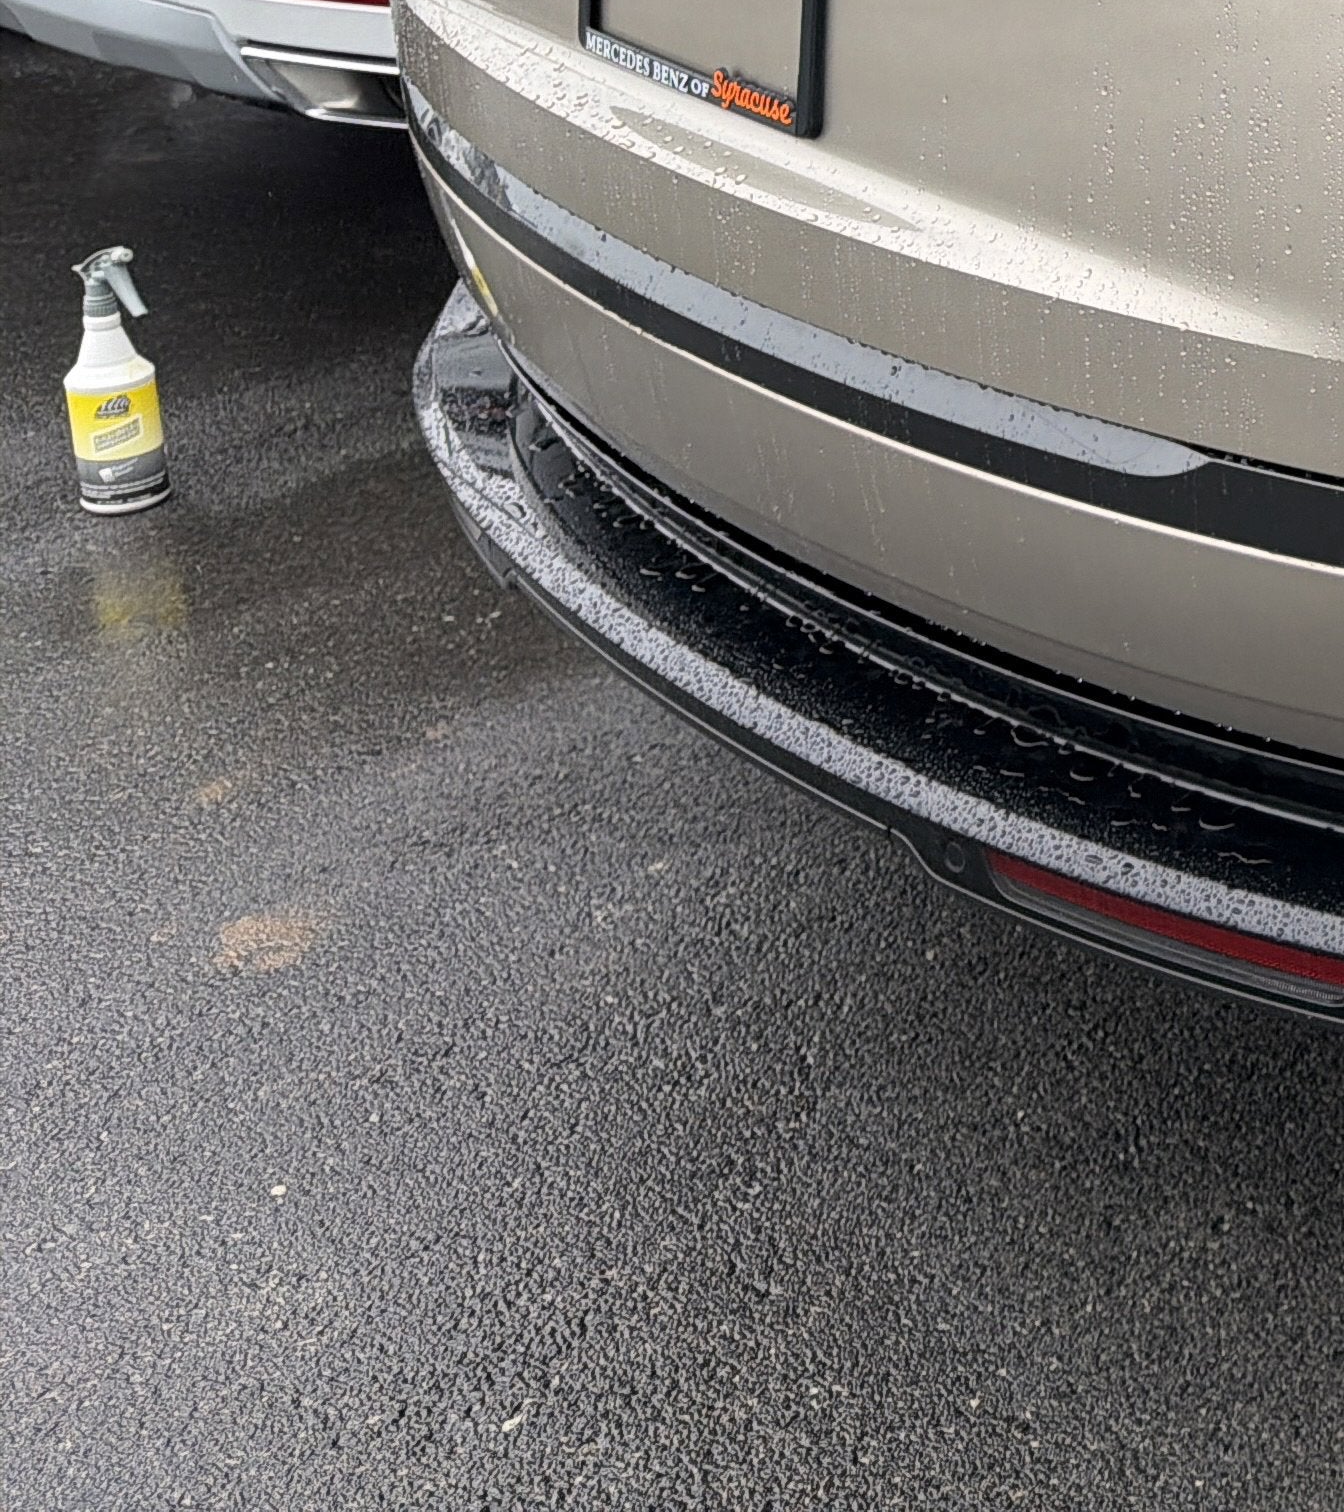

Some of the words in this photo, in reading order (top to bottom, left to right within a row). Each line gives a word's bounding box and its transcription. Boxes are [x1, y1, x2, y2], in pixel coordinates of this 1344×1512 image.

[585, 31, 651, 77] MERCEDES
[652, 61, 689, 94] BENZ
[690, 79, 710, 99] OF
[710, 69, 793, 126] Syracuse
